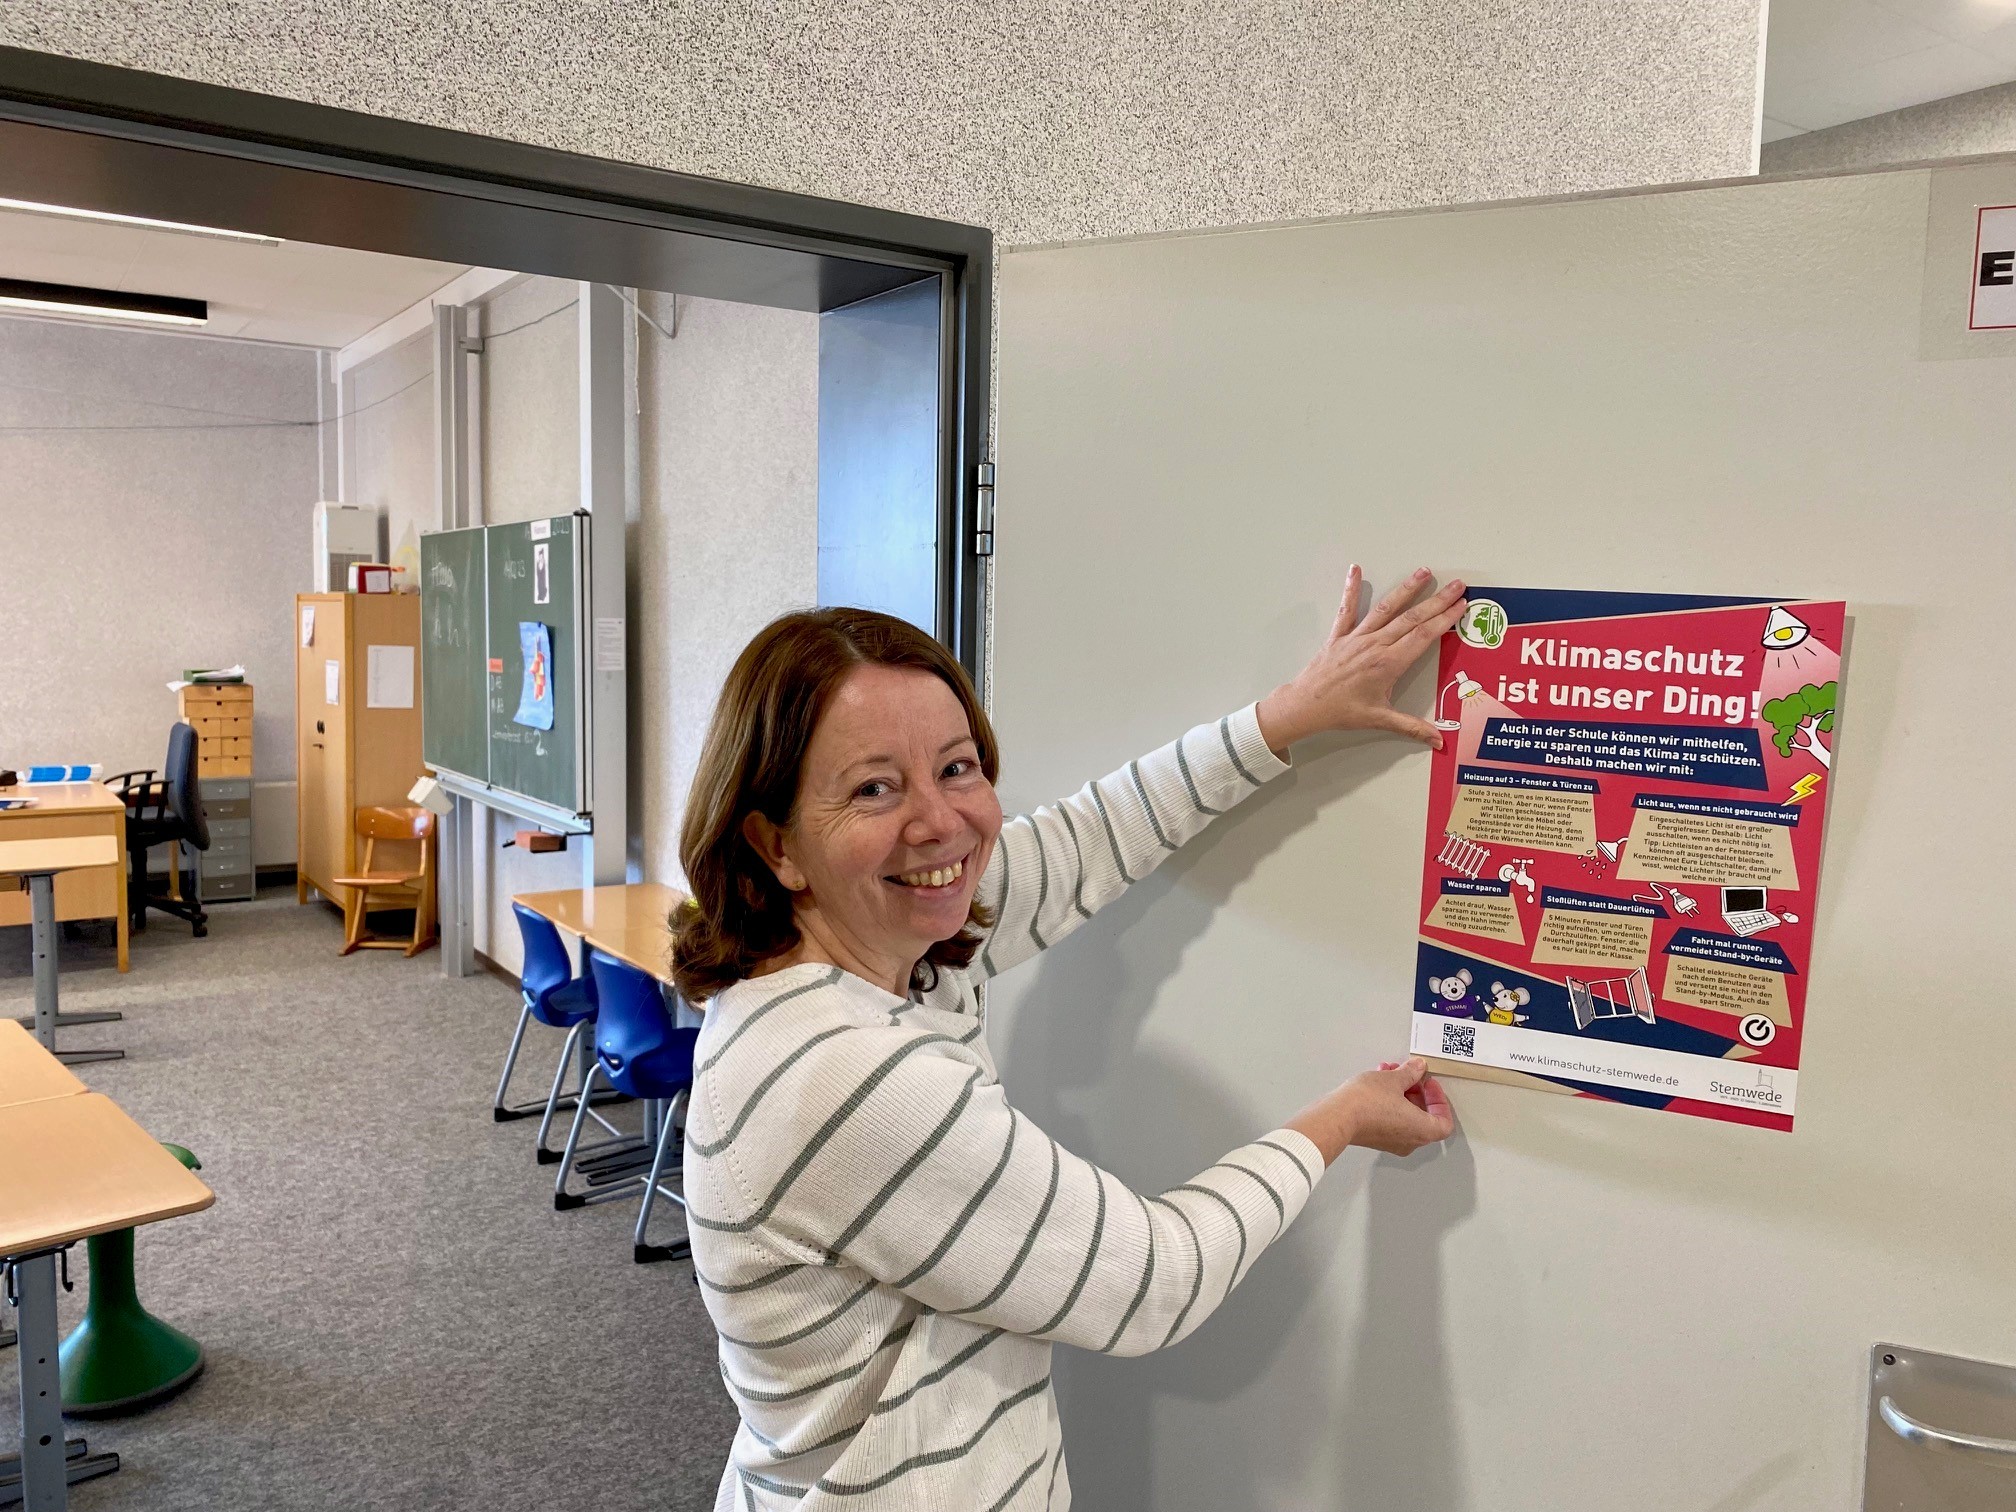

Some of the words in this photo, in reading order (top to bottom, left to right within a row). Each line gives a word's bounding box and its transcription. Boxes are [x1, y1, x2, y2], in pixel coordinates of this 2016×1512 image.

[1980, 250, 2015, 286] E
[1520, 638, 1745, 678] Klimaschutz
[1497, 674, 1539, 704] ist
[1549, 684, 1652, 712] unser
[1663, 686, 1761, 724] Ding!
[1500, 723, 1528, 734] Auch
[1532, 726, 1542, 735] in
[1545, 726, 1565, 737] der
[1568, 728, 1608, 740] Schule
[1611, 731, 1655, 744] können
[1658, 736, 1679, 746] wir
[1682, 738, 1748, 752] mithelfen,
[1486, 736, 1531, 749] Energie
[1534, 742, 1547, 750] zu
[1550, 743, 1590, 753] sparen
[1594, 745, 1616, 755] und
[1619, 746, 1640, 757] das
[1644, 748, 1679, 760] Klima
[1682, 753, 1696, 761] zu
[1700, 753, 1761, 766] schützen.
[1545, 753, 1592, 766] Deshalb
[1596, 760, 1642, 771] machen
[1645, 763, 1666, 773] wir
[1669, 765, 1693, 775] mit:
[1464, 773, 1493, 783] Heizung
[1521, 778, 1550, 787] Fenster
[1559, 781, 1581, 789] Türen
[1544, 796, 1589, 805] Klassenraum
[1649, 816, 1703, 826] Eingeschaltetes
[1734, 809, 1776, 818] gebraucht
[1657, 824, 1710, 834] Energiefresser.
[1712, 829, 1742, 837] Deshalb:
[1644, 839, 1660, 847] Tipp:
[1662, 841, 1702, 850] Lichtleisten
[1728, 848, 1774, 858] Fensterseite
[1646, 832, 1689, 841] ausschalten,
[1741, 840, 1759, 848] nötig
[1633, 853, 1679, 863] Kennzeichnet
[1699, 860, 1746, 871] Lichtschalter,
[1649, 847, 1674, 855] können
[1686, 852, 1735, 861] ausgeschaltet
[1737, 856, 1766, 864] bleiben.
[1447, 881, 1474, 889] Wasser
[1547, 896, 1586, 906] Stoßlüften
[1608, 903, 1654, 914] Dauerlüften
[1554, 915, 1580, 923] Minuten
[1582, 918, 1607, 927] Fenster
[1544, 922, 1564, 930] richtig
[1566, 925, 1599, 934] aufreißen,
[1613, 931, 1648, 939] ordentlich
[1550, 930, 1598, 940] Durchzulüften.
[1600, 936, 1627, 945] Fenster,
[1542, 936, 1573, 945] dauerhaft
[1691, 937, 1713, 945] Fahrt
[1732, 943, 1762, 952] runter:
[1670, 946, 1711, 955] vermeidet
[1713, 950, 1782, 964] Stand-by-Geräte
[1677, 965, 1705, 973] Schaltet
[1707, 969, 1746, 979] elektrische
[1748, 974, 1773, 982] Geräte
[1717, 978, 1751, 987] Benutzen
[1676, 987, 1735, 1000] Stand-by-Modus.
[1719, 1001, 1743, 1009] Strom.
[1509, 1052, 1679, 1086] www.klimaschutz-stemwede.de
[1710, 1081, 1782, 1102] Stemwede
